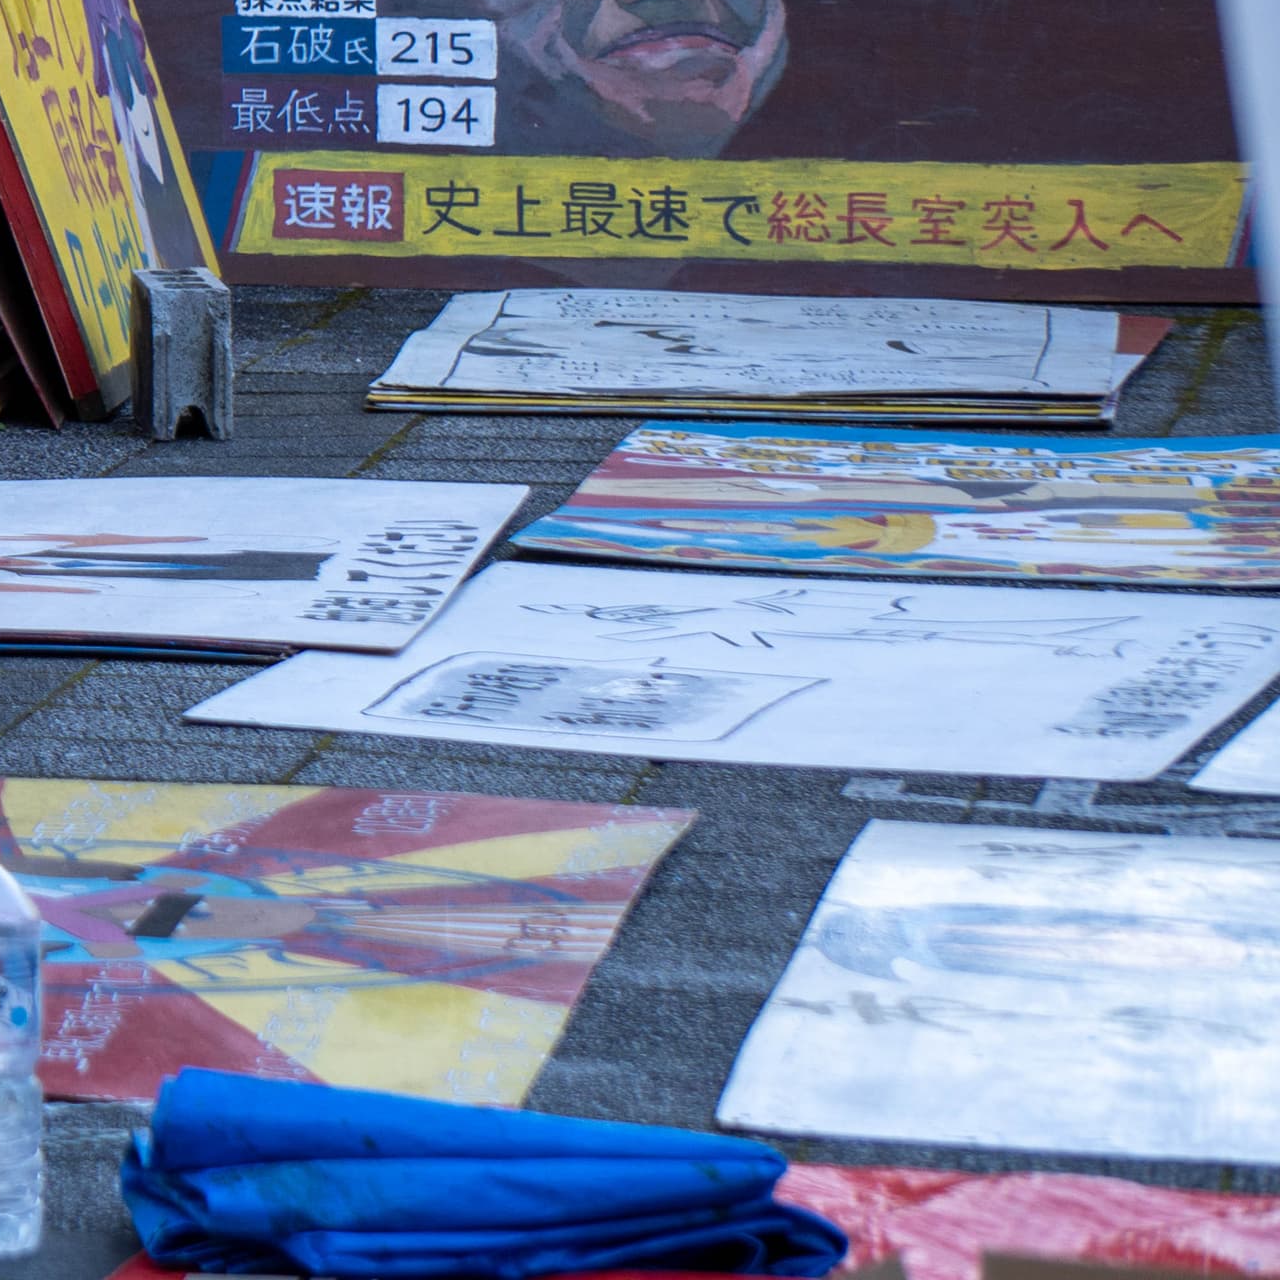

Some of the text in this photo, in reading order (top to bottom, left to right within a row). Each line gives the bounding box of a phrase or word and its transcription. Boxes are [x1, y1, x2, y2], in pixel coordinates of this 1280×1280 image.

[240, 24, 474, 66] 石破氏 215
[43, 84, 127, 210] 同好会
[232, 89, 478, 134] 最低点 194
[283, 180, 1184, 252] 速報 史上最速で総長室突入へ
[296, 519, 479, 625] 勉強してください
